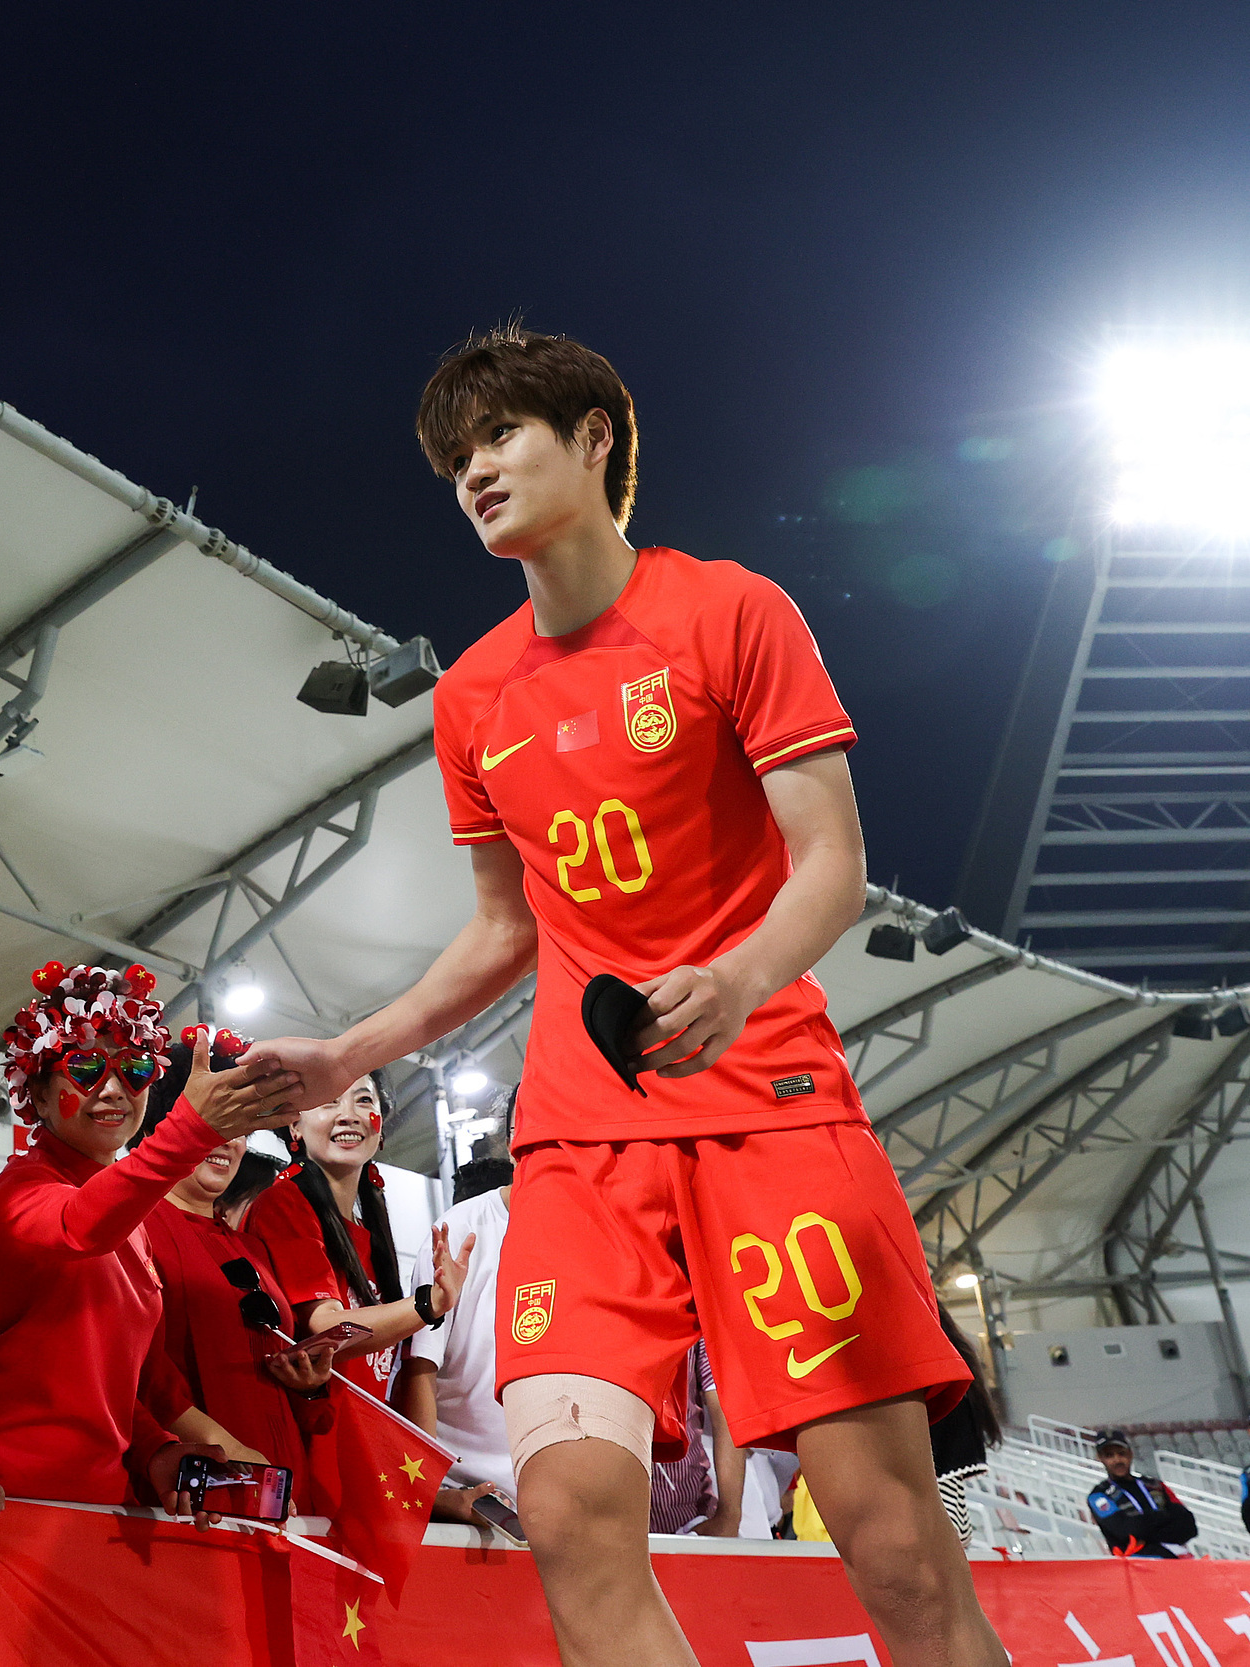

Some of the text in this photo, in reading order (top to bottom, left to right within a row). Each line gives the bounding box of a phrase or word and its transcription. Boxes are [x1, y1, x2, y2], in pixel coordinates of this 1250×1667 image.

[627, 675, 664, 701] CFA
[547, 798, 653, 903] 20
[518, 1284, 552, 1301] CFA
[730, 1211, 863, 1341] 20
